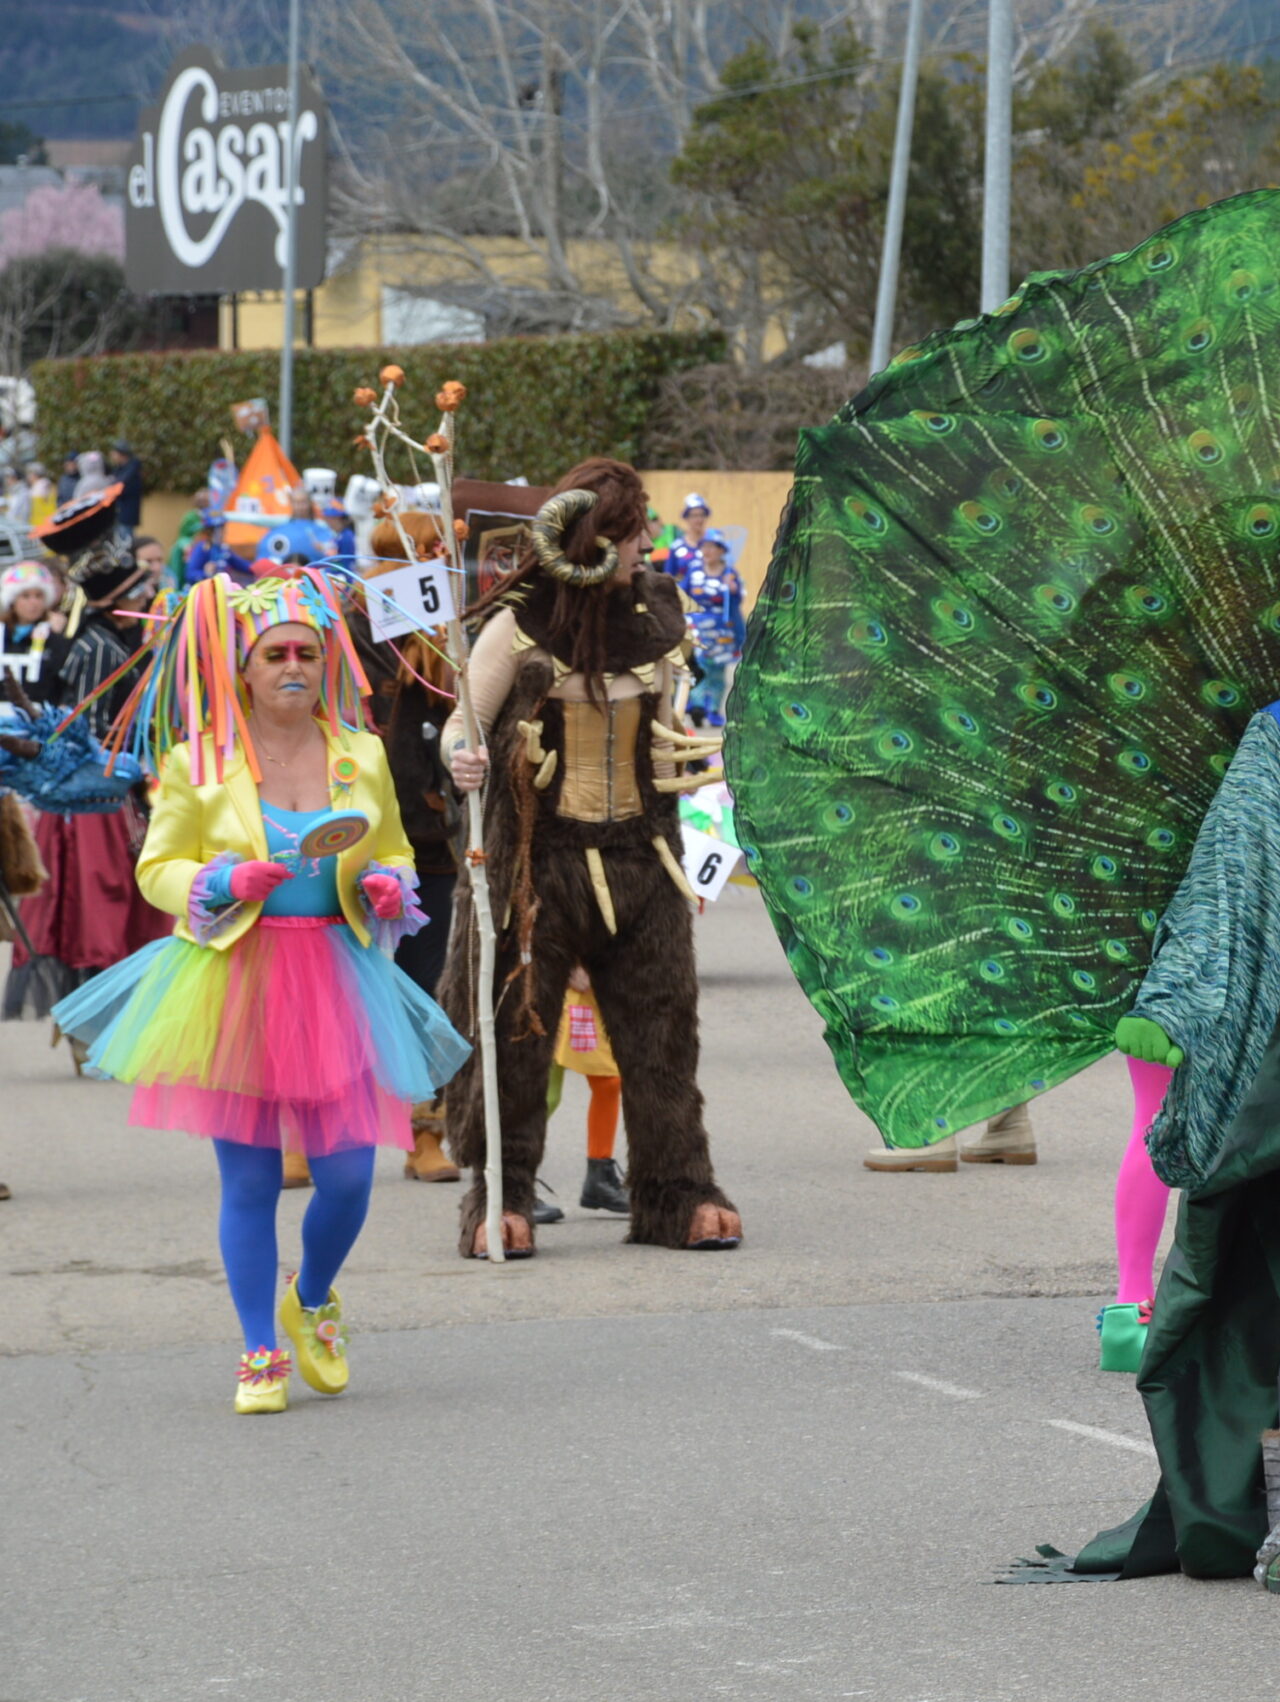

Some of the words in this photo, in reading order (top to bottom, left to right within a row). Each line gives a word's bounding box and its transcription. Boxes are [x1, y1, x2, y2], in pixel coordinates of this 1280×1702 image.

[219, 87, 291, 118] EVENTO
[129, 131, 155, 208] el
[157, 66, 317, 268] Casar
[419, 575, 440, 613] 5
[697, 852, 722, 885] 6
